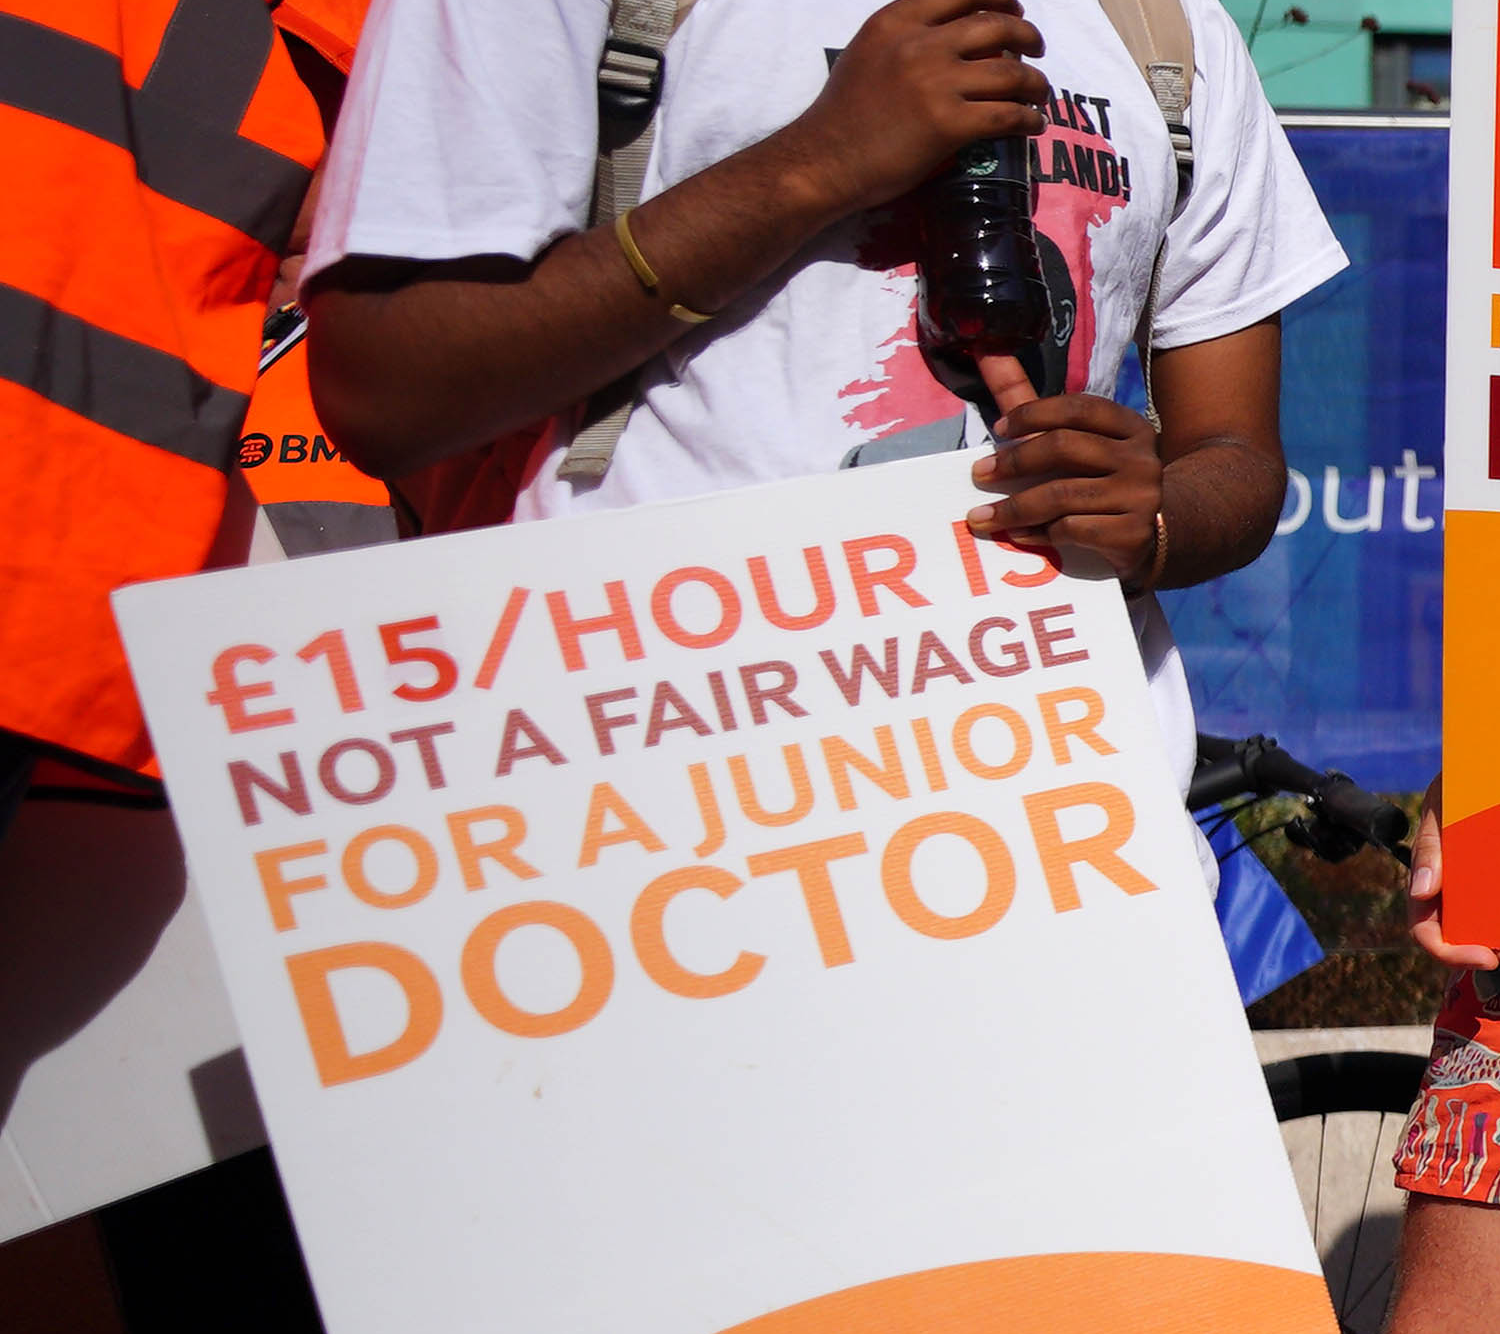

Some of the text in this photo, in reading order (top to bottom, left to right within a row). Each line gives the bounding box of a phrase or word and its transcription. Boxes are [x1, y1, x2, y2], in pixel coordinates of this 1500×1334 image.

[278, 434, 348, 463] BM
[207, 531, 931, 734] £15/HOUR
[229, 605, 1090, 827] NOT A FAIR WAGE
[256, 684, 1119, 934] FOR A JUNIOR
[284, 780, 1159, 1089] DOCTOR
